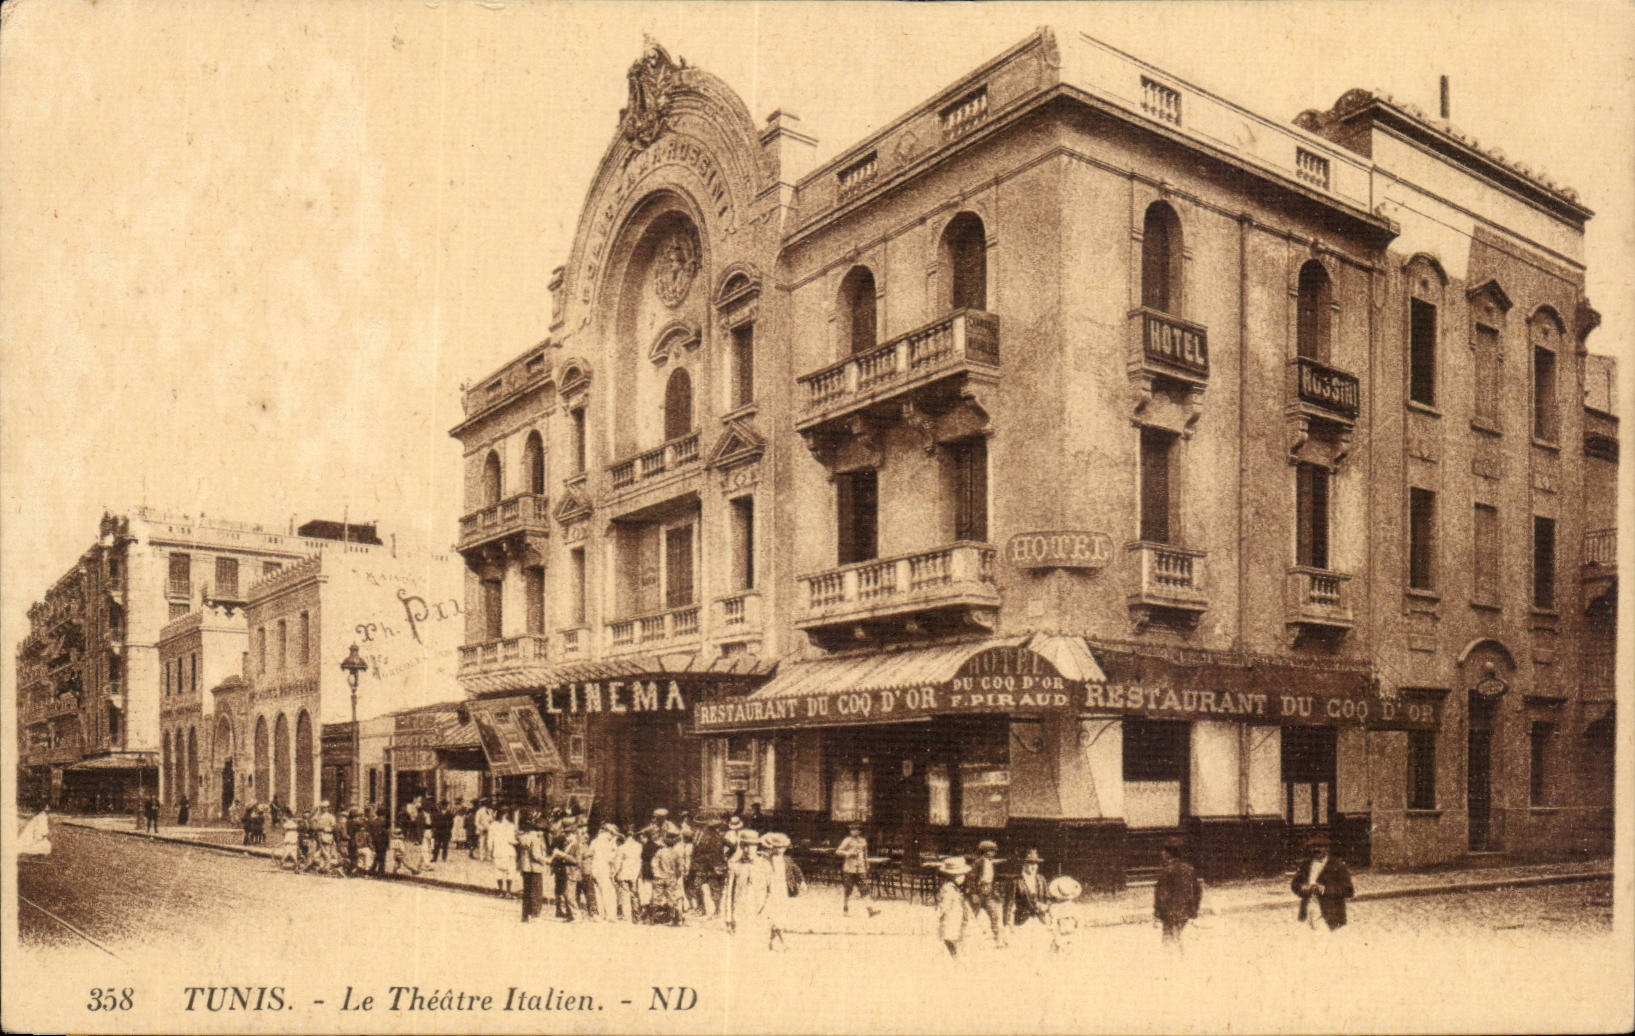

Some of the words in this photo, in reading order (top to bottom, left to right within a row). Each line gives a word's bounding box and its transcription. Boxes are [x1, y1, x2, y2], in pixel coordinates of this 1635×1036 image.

[1150, 322, 1204, 364] HOTEL
[1010, 535, 1109, 563] HOTEL
[968, 647, 1044, 675] HOTEL
[545, 679, 686, 714] CINEMA
[952, 677, 974, 691] DU
[981, 675, 1015, 692] COQ
[1022, 676, 1065, 690] D'OR
[700, 698, 798, 724] RESTAURANT
[807, 695, 829, 717] DU
[838, 691, 872, 717] COQ
[880, 687, 938, 713] D'OR
[1084, 682, 1268, 715] RESTAURANT
[1280, 696, 1314, 718] DU
[1327, 699, 1369, 724] COQ
[1382, 702, 1435, 724] D'OR
